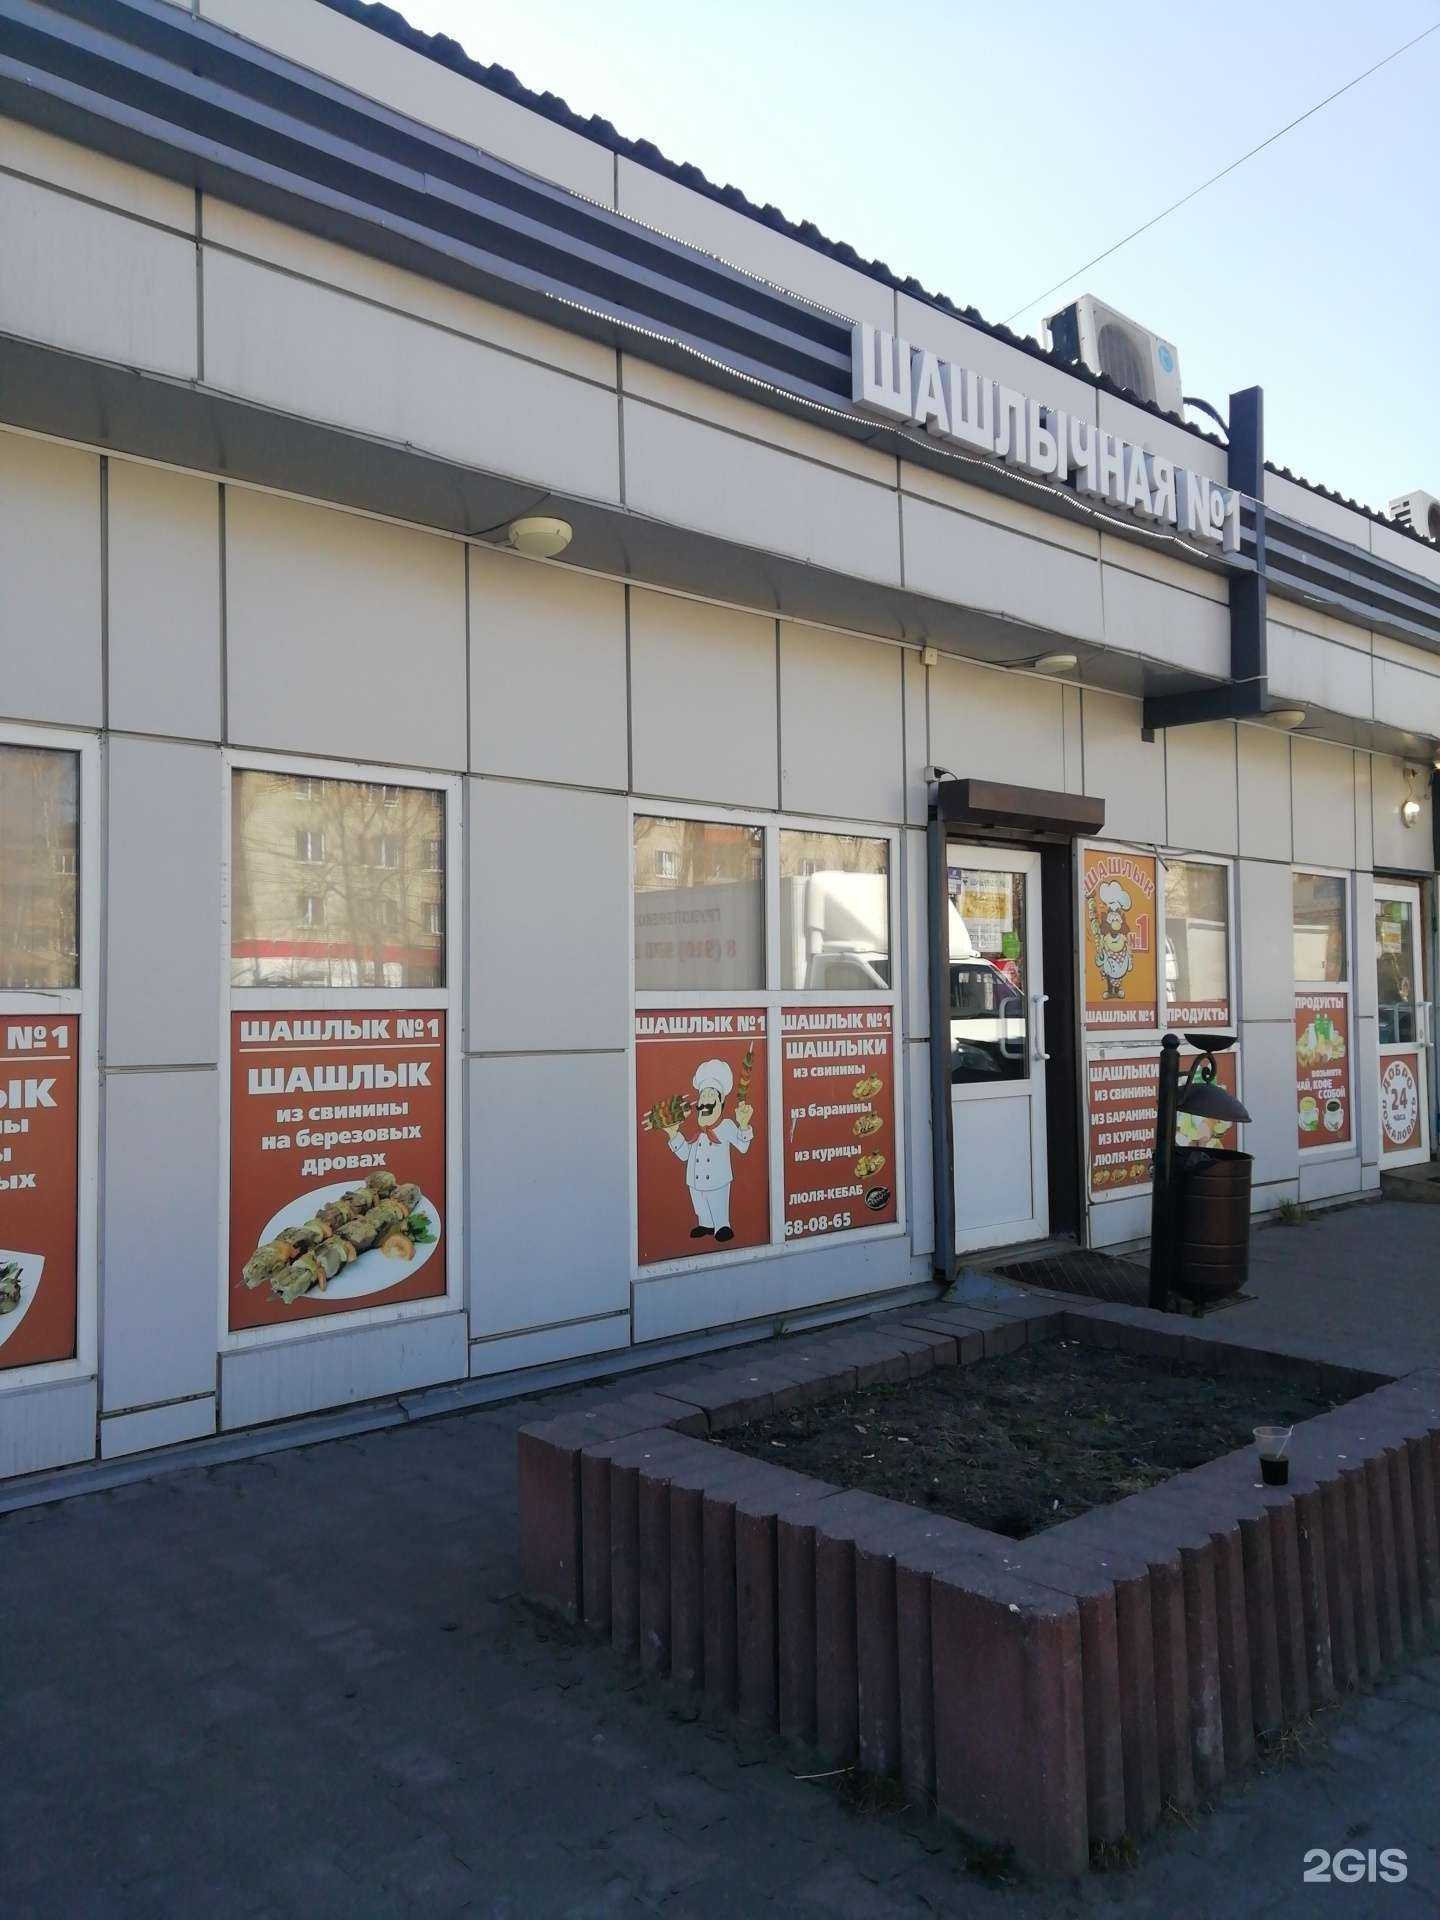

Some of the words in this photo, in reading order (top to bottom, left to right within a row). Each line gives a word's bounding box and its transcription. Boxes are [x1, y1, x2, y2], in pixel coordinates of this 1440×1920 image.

[852, 322, 1177, 525] ШАШЛЫЧНАЯ
[1084, 857, 1154, 899] ШАШЛЫК
[1296, 997, 1344, 1010] ПРОДУКТЫ
[782, 1013, 864, 1031] ШАШЛЫК
[866, 1013, 891, 1029] №1
[1086, 1010, 1136, 1023] ШАШЛЫК
[1167, 1007, 1229, 1023] ПРОДУКТЫ
[240, 1019, 391, 1042] ШАШЛЫК
[396, 1018, 440, 1038] №1
[636, 1016, 735, 1035] ШАШЛЫК
[737, 1015, 767, 1032] №1
[786, 1039, 887, 1060] ШАШЛЫКИ
[247, 1062, 432, 1095] ШАШЛЫК
[793, 1068, 808, 1079] из
[811, 1064, 866, 1078] свинины
[1089, 1063, 1160, 1082] ШАШЛЫКИ
[1095, 1089, 1108, 1101] ИЗ
[1109, 1085, 1156, 1100] СВИНИНЫ
[1313, 1079, 1333, 1090] КОФЕ
[1391, 1088, 1408, 1110] 24
[276, 1107, 303, 1123] из
[308, 1100, 409, 1123] свинины
[791, 1106, 806, 1119] из
[808, 1101, 872, 1118] баранины
[1092, 1113, 1105, 1125] ИЗ
[261, 1133, 291, 1150] на
[295, 1124, 423, 1151] березовых
[1099, 1133, 1111, 1145] ИЗ
[1113, 1128, 1154, 1144] КУРИЦЫ
[795, 1149, 810, 1162] из
[812, 1144, 862, 1162] курицы
[1094, 1151, 1153, 1167] ЛЮЛЯ-КЕБА
[301, 1151, 386, 1177] дровах
[789, 1184, 864, 1206] ЛЮЛЯ-КЕБАБ
[785, 1212, 851, 1237] 68-08-65
